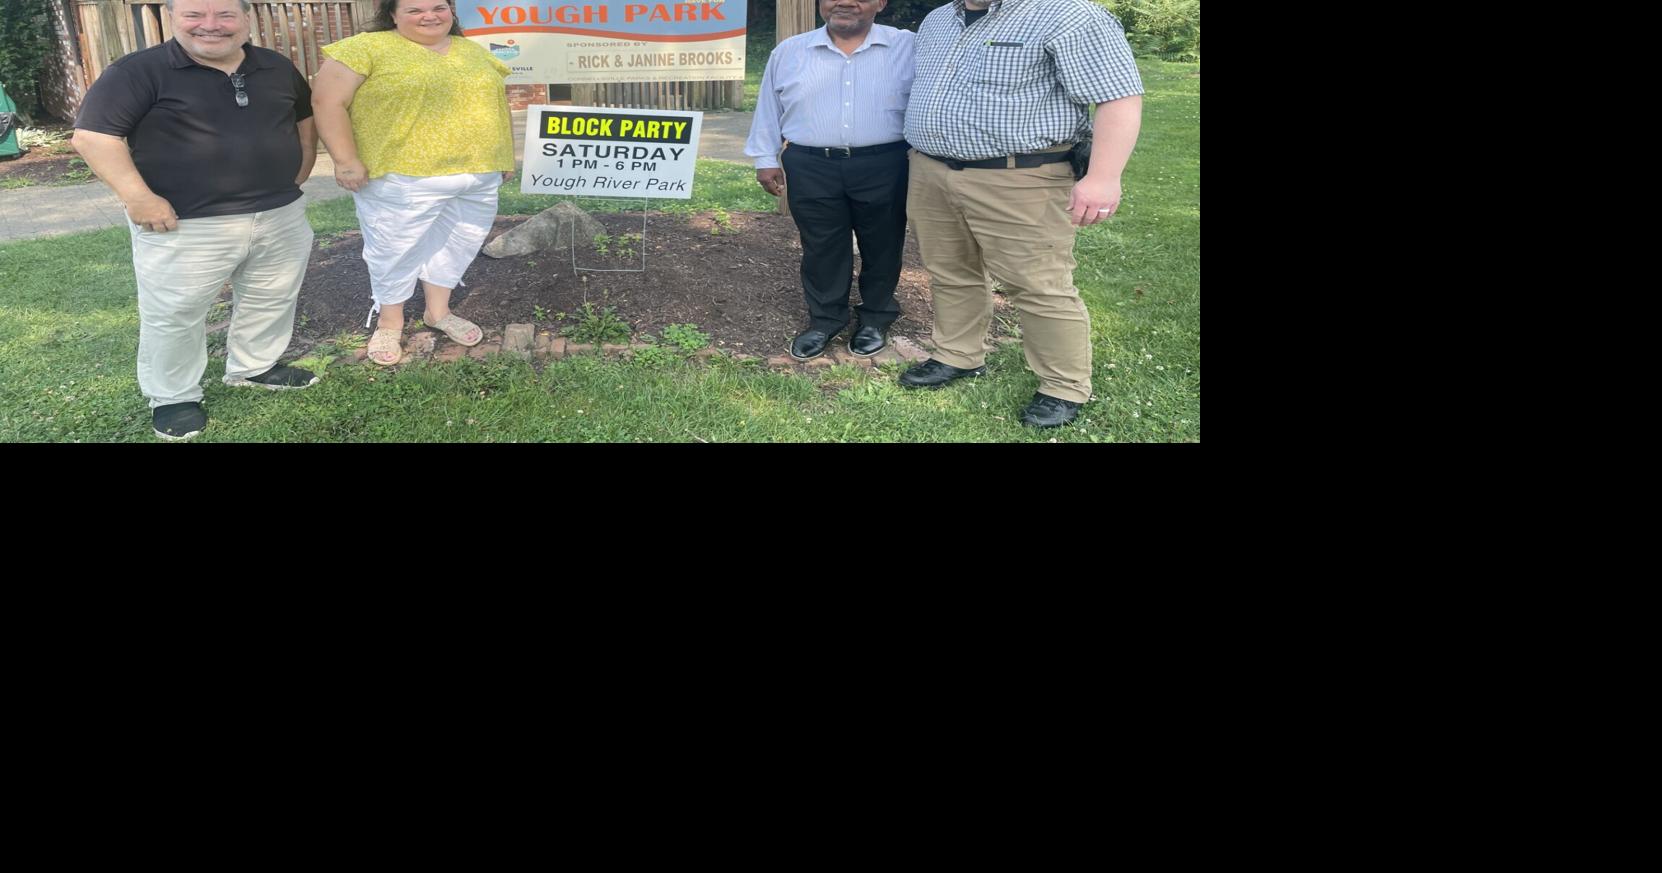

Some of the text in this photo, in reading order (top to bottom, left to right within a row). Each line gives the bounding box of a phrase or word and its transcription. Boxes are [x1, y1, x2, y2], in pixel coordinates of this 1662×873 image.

[476, 3, 726, 25] YOUGH PARK
[578, 55, 610, 69] RICK
[614, 54, 623, 68] &
[627, 52, 675, 68] JANINE
[679, 51, 733, 66] BROOKS
[547, 116, 687, 140] BLOCK PARTY
[542, 143, 685, 161] SATURDAY
[557, 159, 563, 168] 1
[572, 159, 598, 170] PM
[615, 161, 625, 170] 6
[631, 162, 657, 171] PM
[531, 174, 687, 192] Yough River Park
